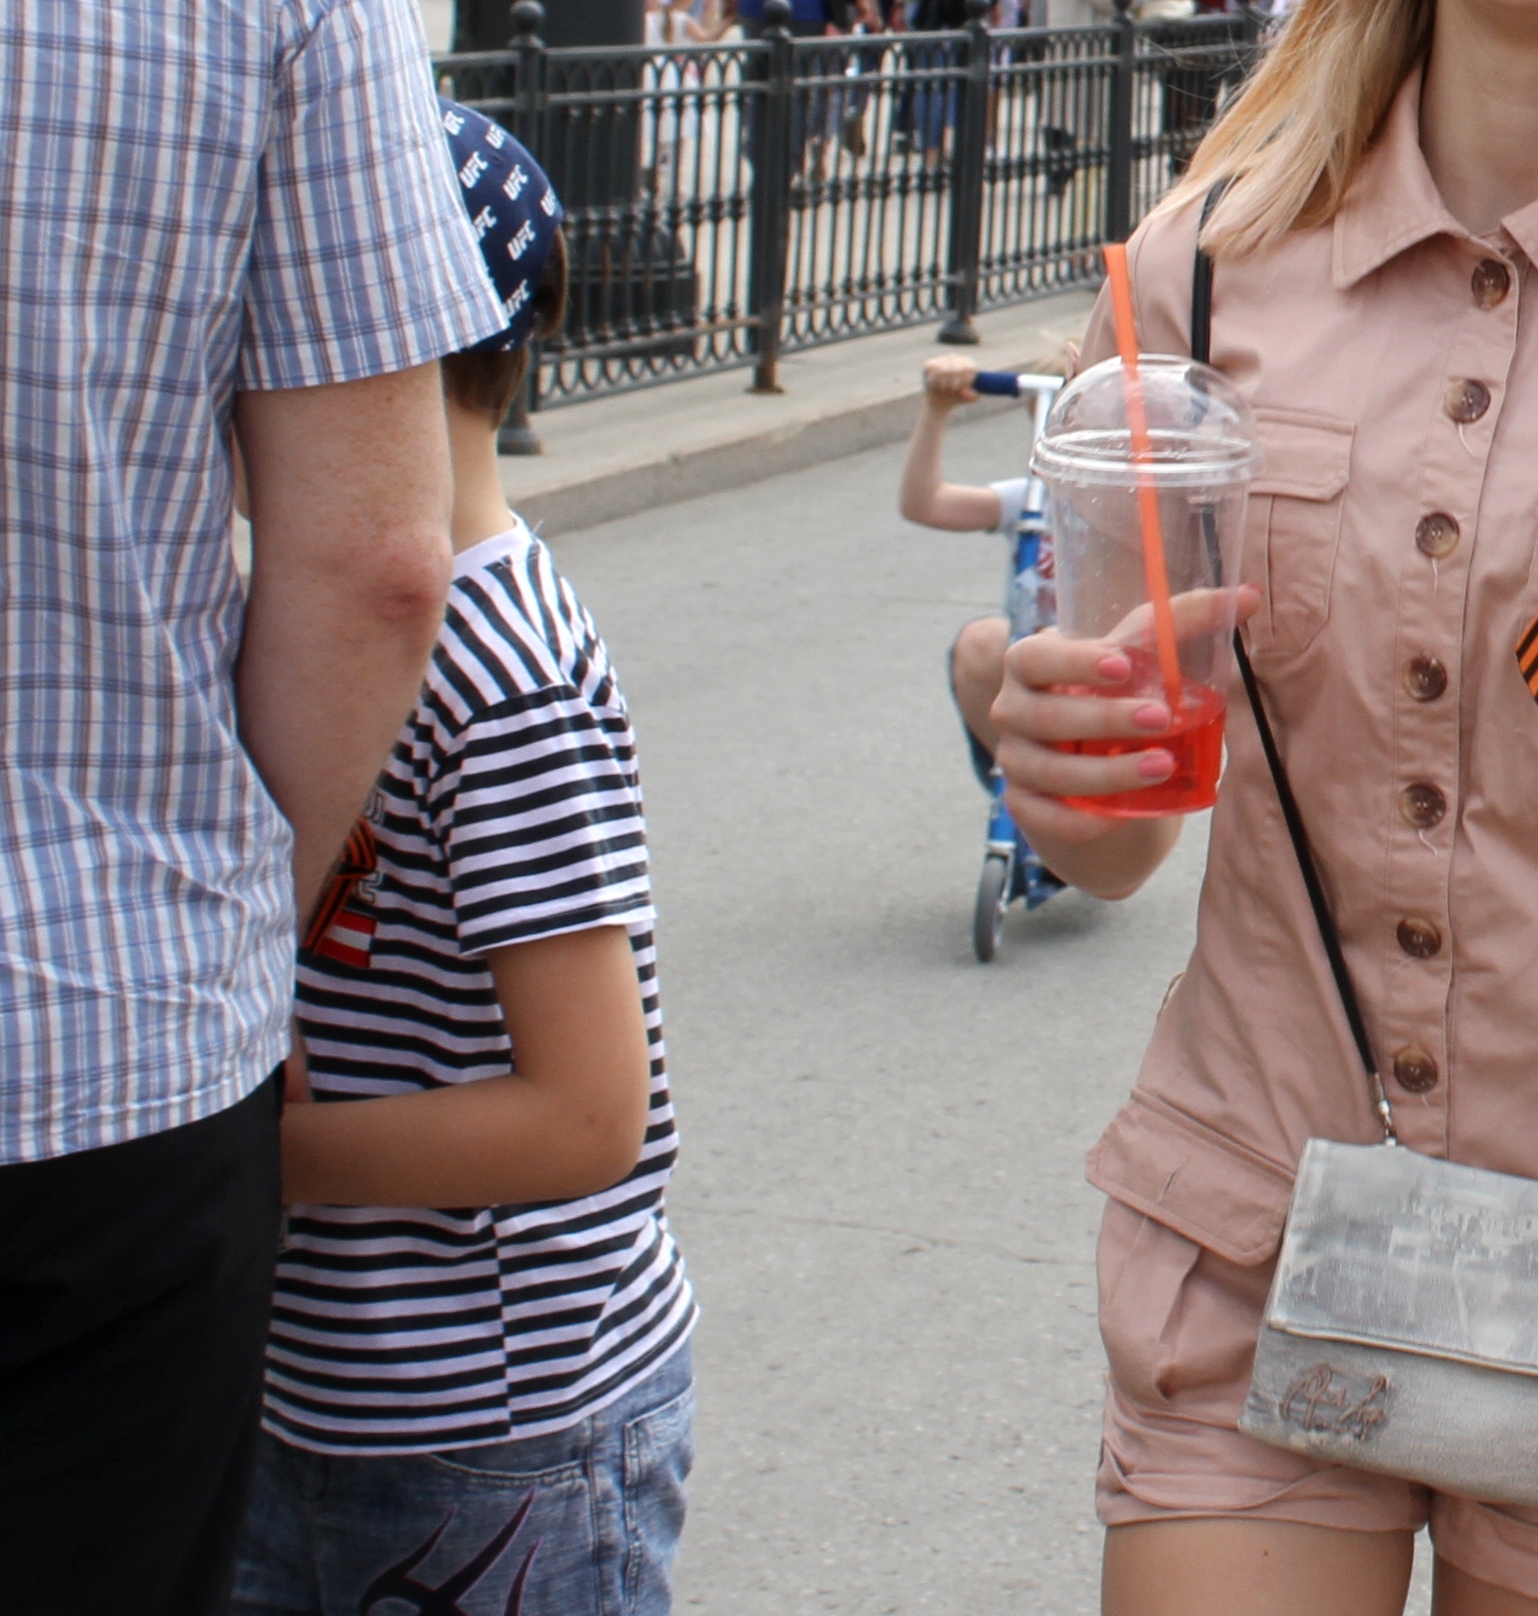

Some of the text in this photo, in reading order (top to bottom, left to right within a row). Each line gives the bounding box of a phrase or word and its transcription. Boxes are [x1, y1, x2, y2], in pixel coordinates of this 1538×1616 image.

[485, 124, 506, 150] UF
[459, 151, 489, 189] UFC
[502, 164, 529, 201] UFC
[472, 205, 498, 239] FC
[507, 219, 536, 261] UFC
